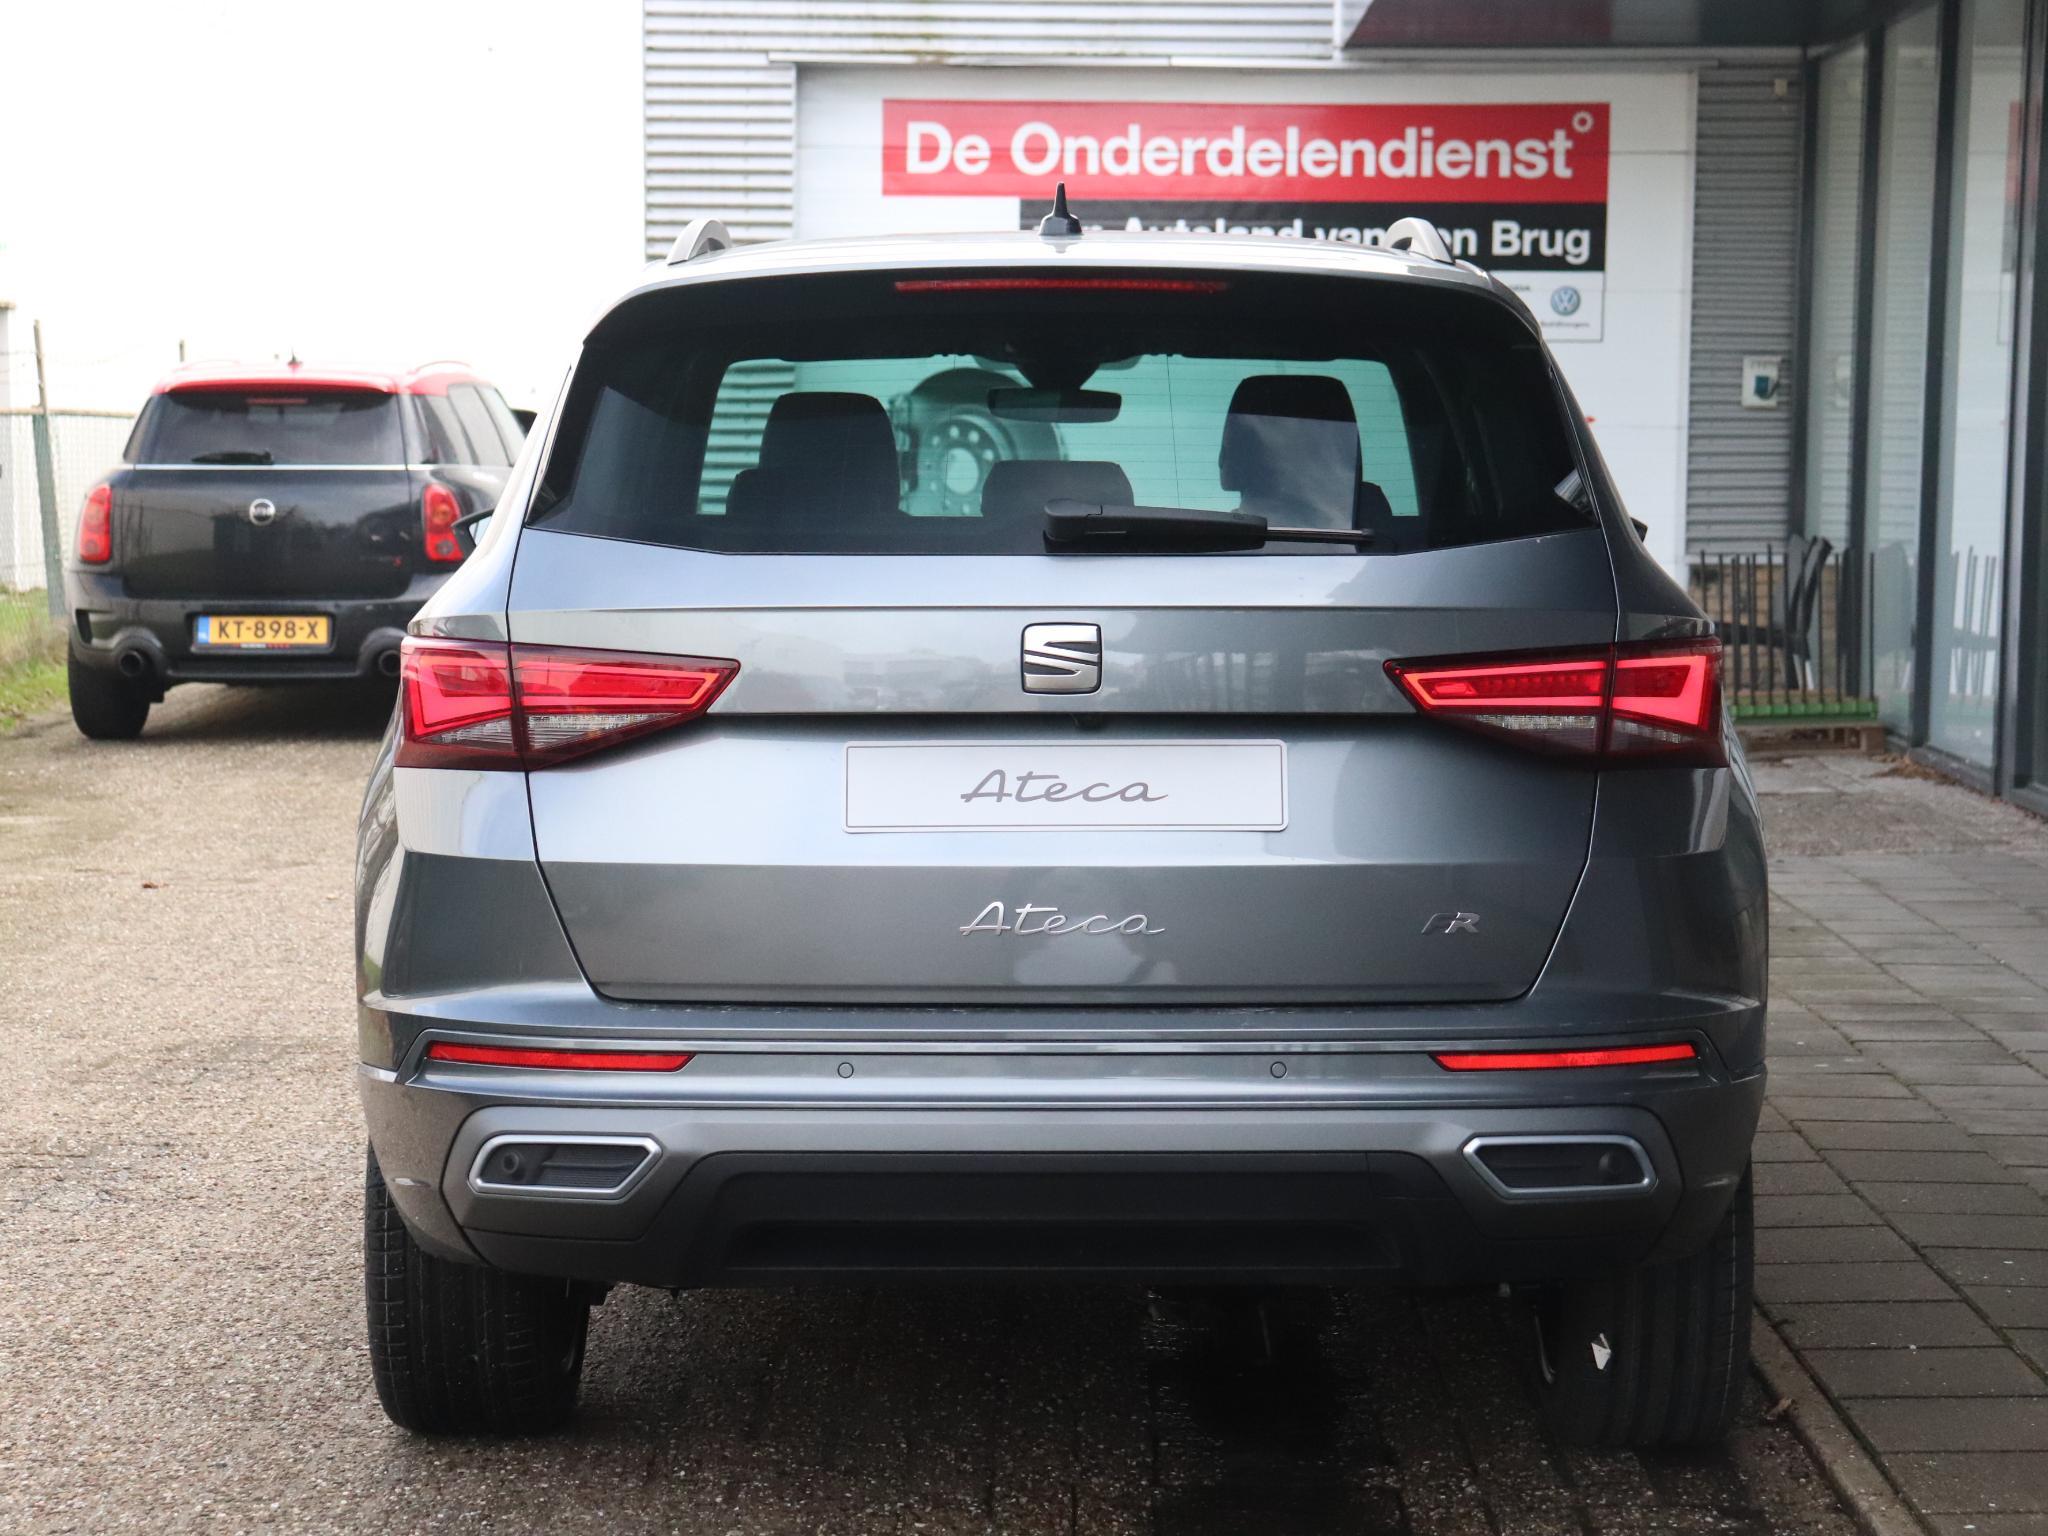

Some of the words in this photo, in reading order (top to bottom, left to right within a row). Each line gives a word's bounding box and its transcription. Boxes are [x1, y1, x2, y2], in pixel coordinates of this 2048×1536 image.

[906, 121, 991, 175] De
[1010, 121, 1573, 179] Onderdelendienst
[1491, 220, 1591, 265] Brug
[218, 620, 319, 639] KT-898-X
[960, 769, 1169, 802] Ateca
[959, 901, 1166, 936] Ateca
